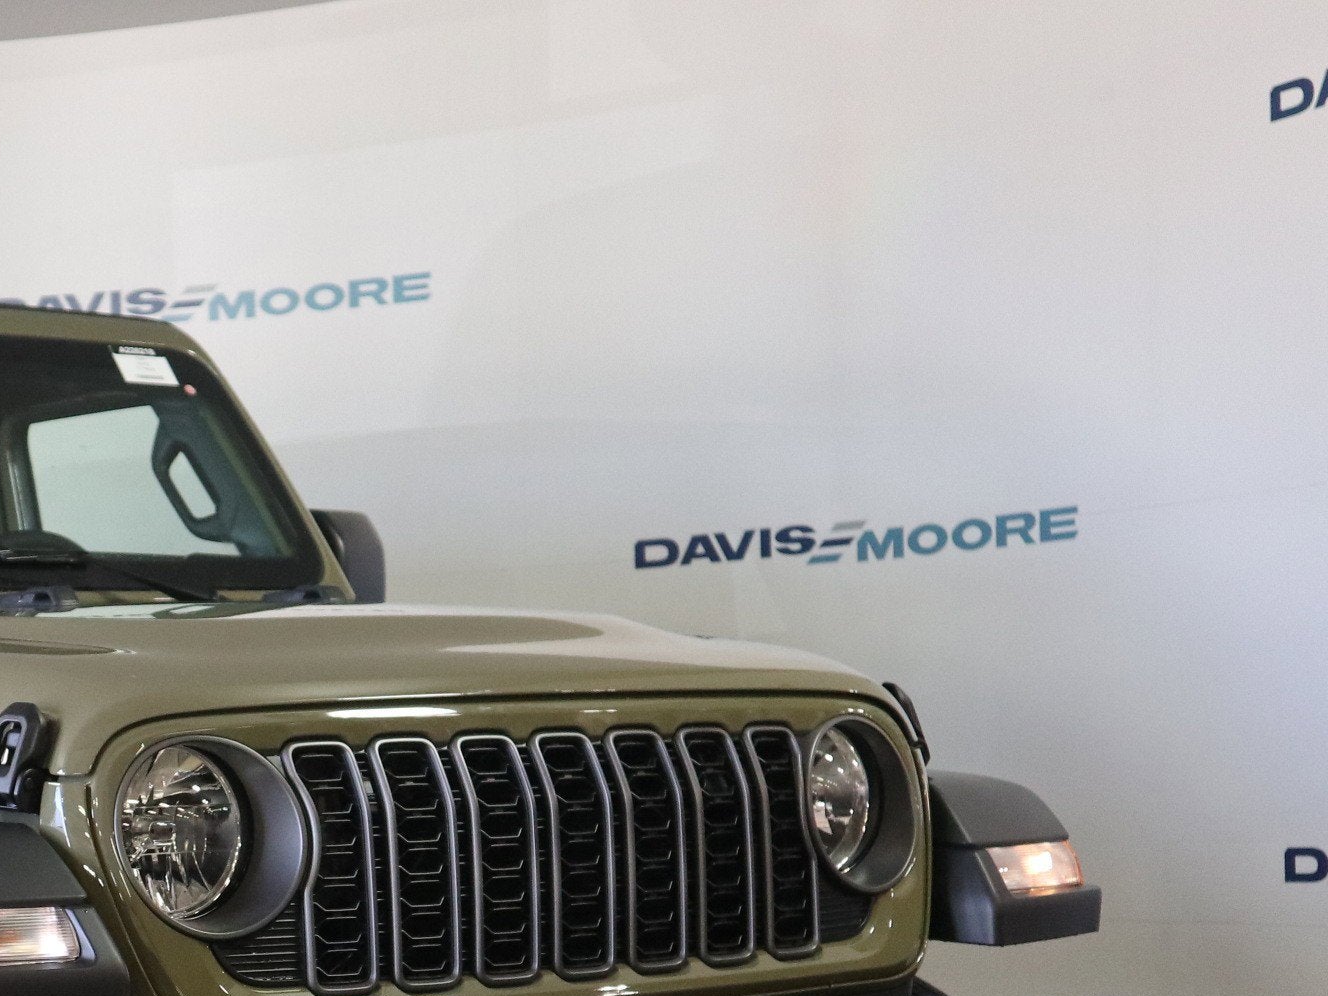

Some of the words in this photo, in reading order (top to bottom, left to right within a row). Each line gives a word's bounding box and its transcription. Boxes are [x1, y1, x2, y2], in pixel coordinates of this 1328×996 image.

[207, 271, 432, 322] MOORE
[633, 524, 817, 570] DAVIS
[856, 505, 1080, 563] MOORE
